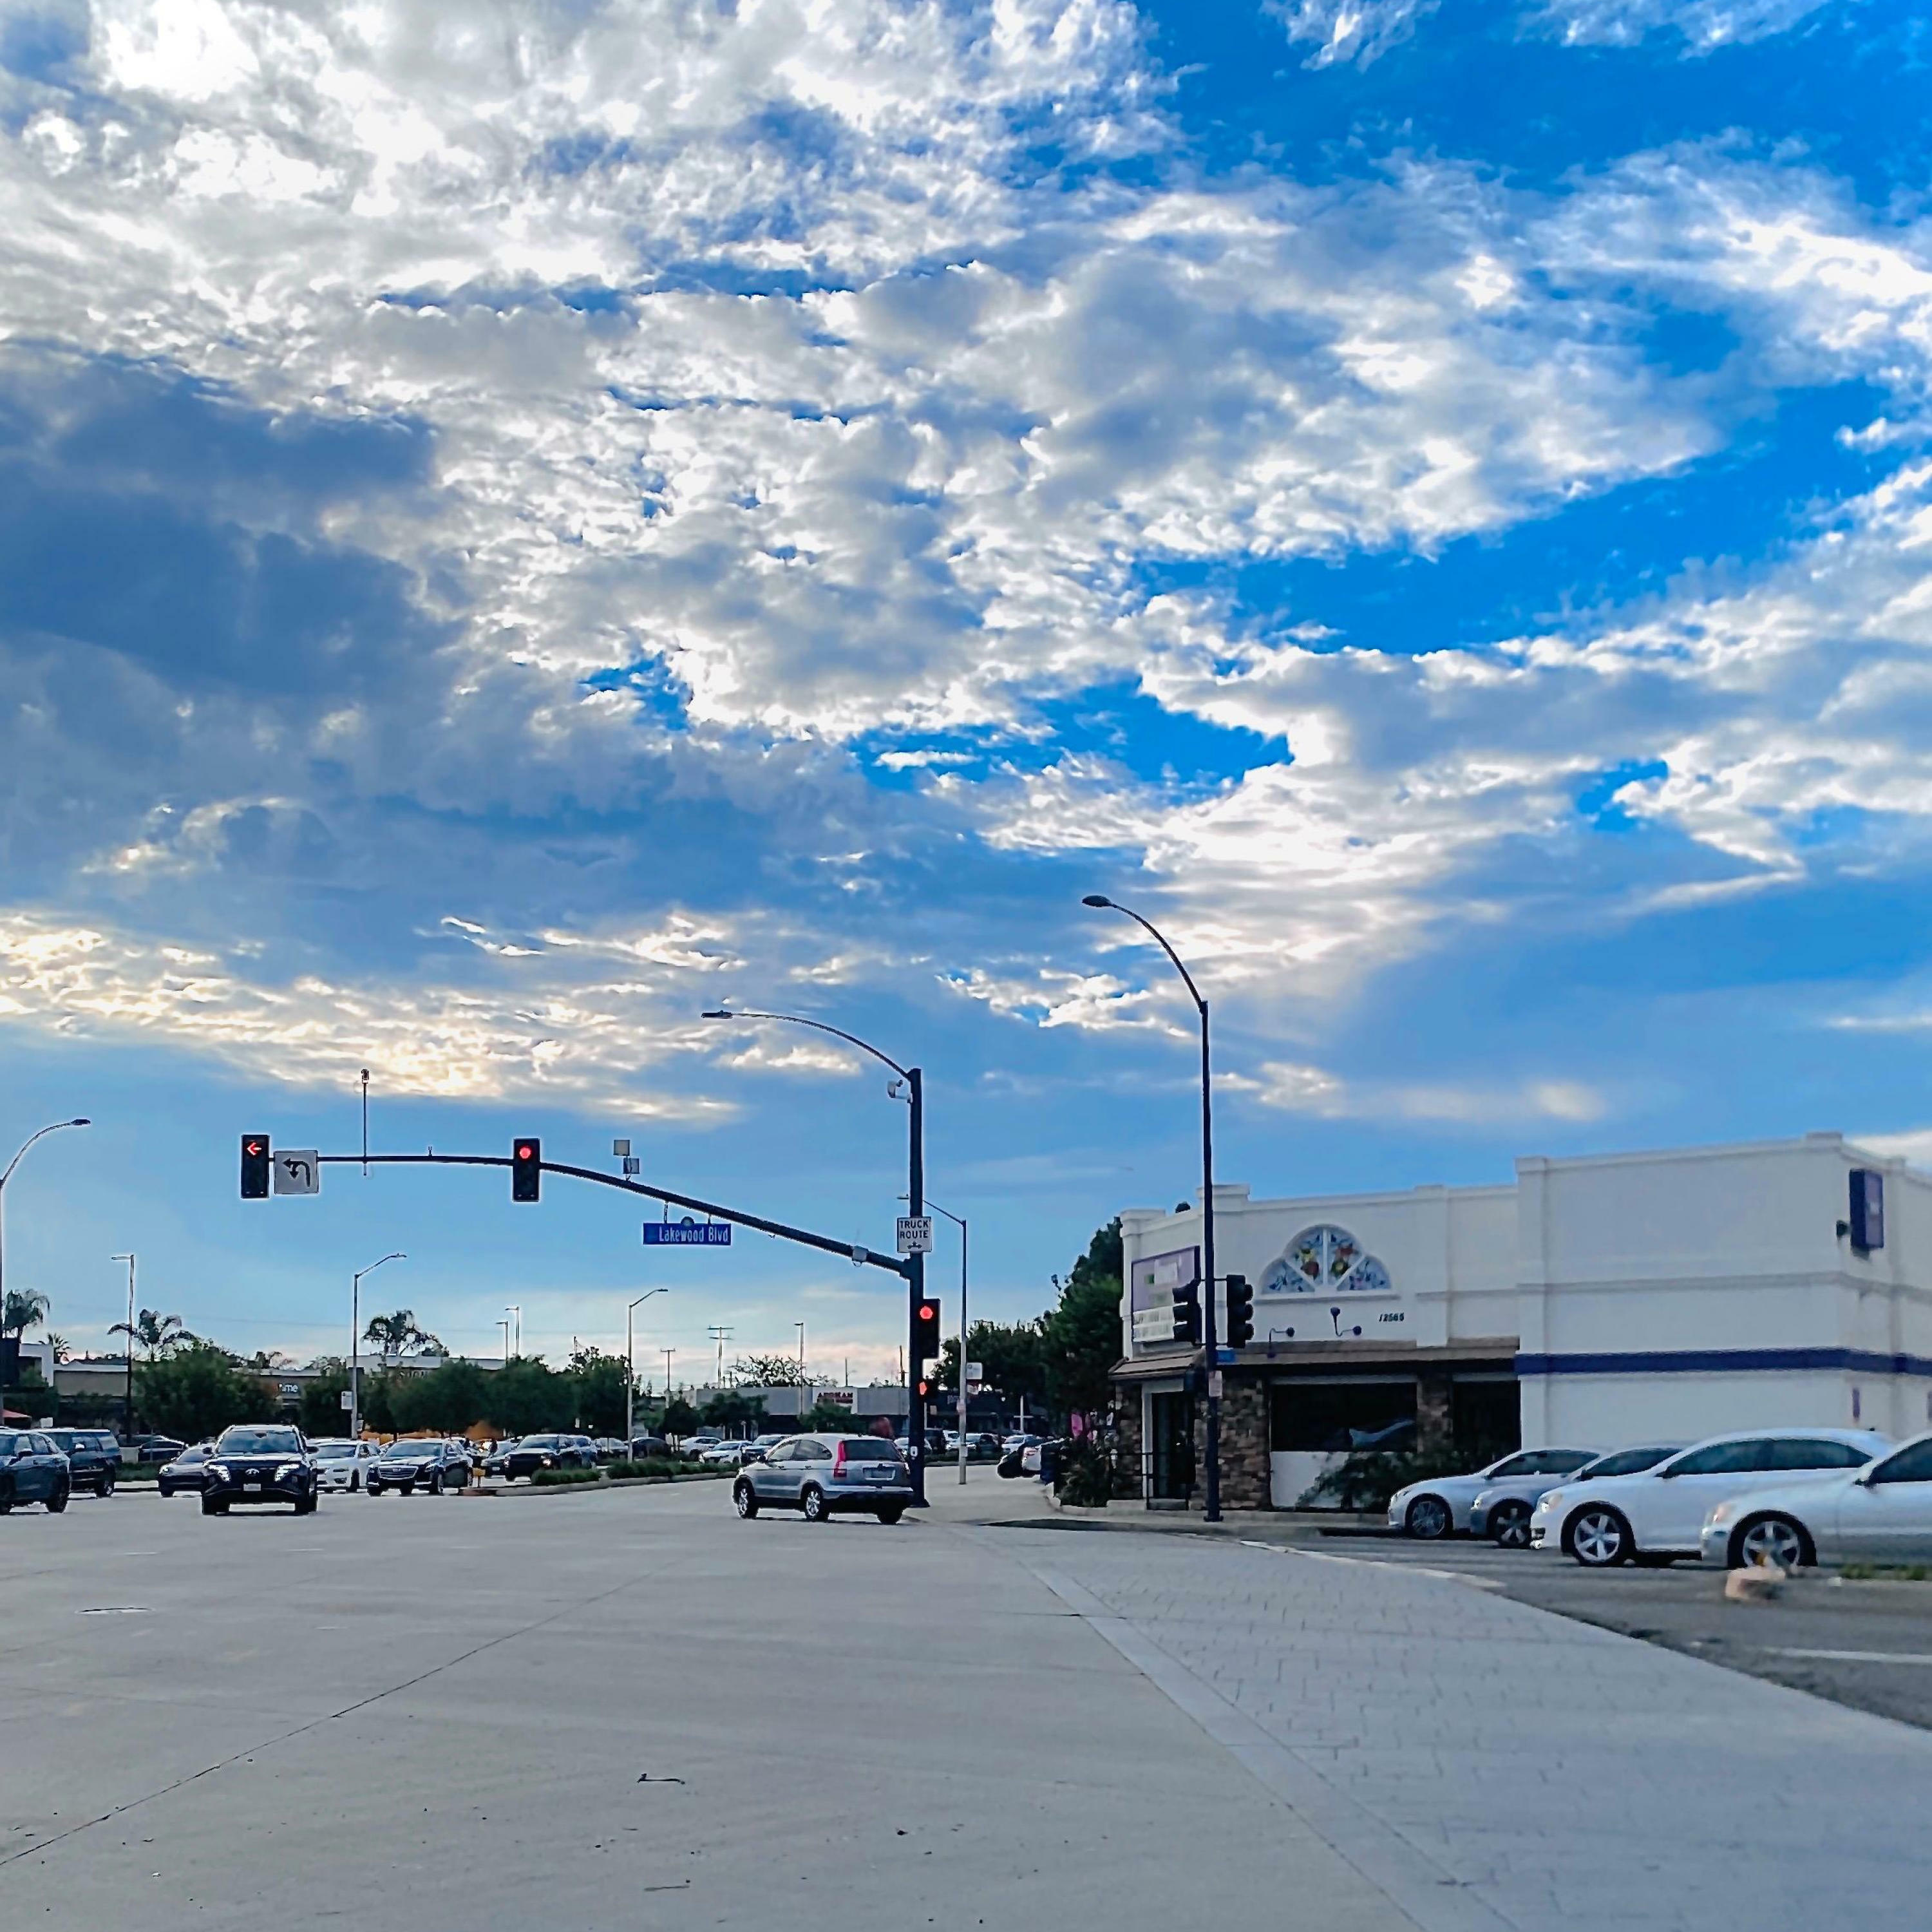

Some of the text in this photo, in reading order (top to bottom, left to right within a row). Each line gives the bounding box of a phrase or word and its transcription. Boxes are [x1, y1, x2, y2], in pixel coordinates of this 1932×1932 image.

[900, 1220, 929, 1229] TRUCK
[659, 1226, 729, 1242] Lakewood Blvd
[900, 1230, 928, 1239] ROUTE
